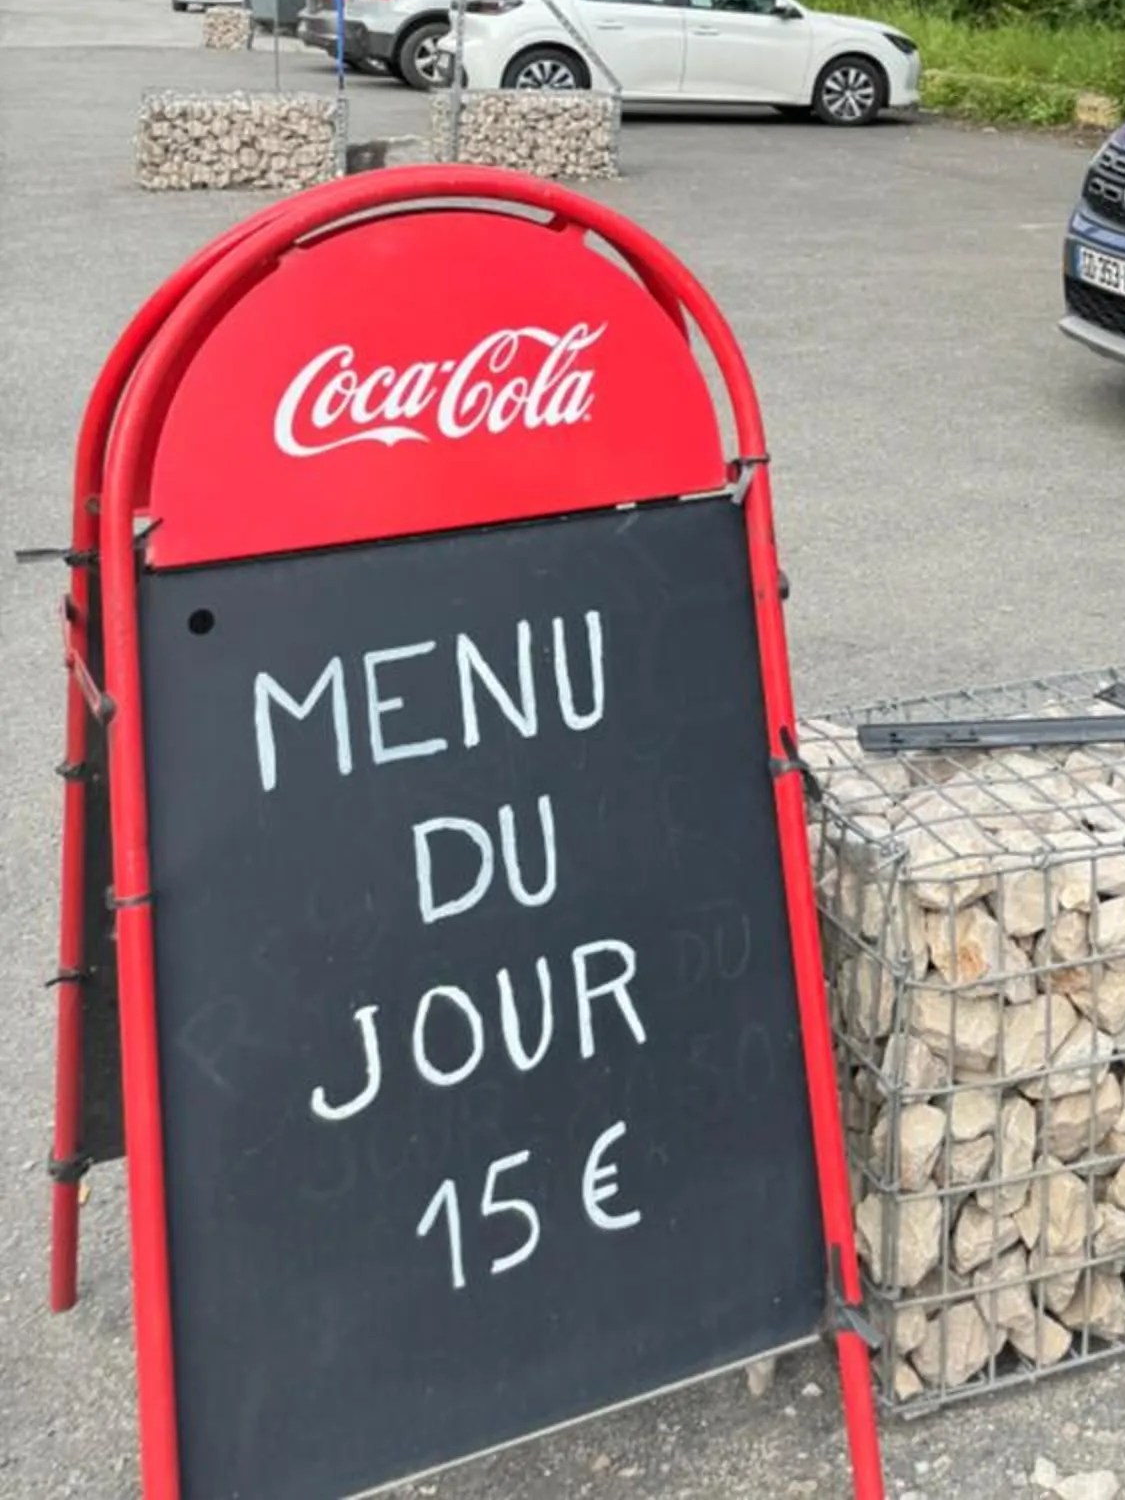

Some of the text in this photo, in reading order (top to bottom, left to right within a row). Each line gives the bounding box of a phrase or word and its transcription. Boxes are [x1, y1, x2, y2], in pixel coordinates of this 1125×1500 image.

[274, 321, 608, 457] Coca-Cola
[253, 610, 604, 792] MENU
[412, 794, 557, 924] DU
[311, 938, 647, 1120] JOUR
[416, 1121, 641, 1289] 15 €
